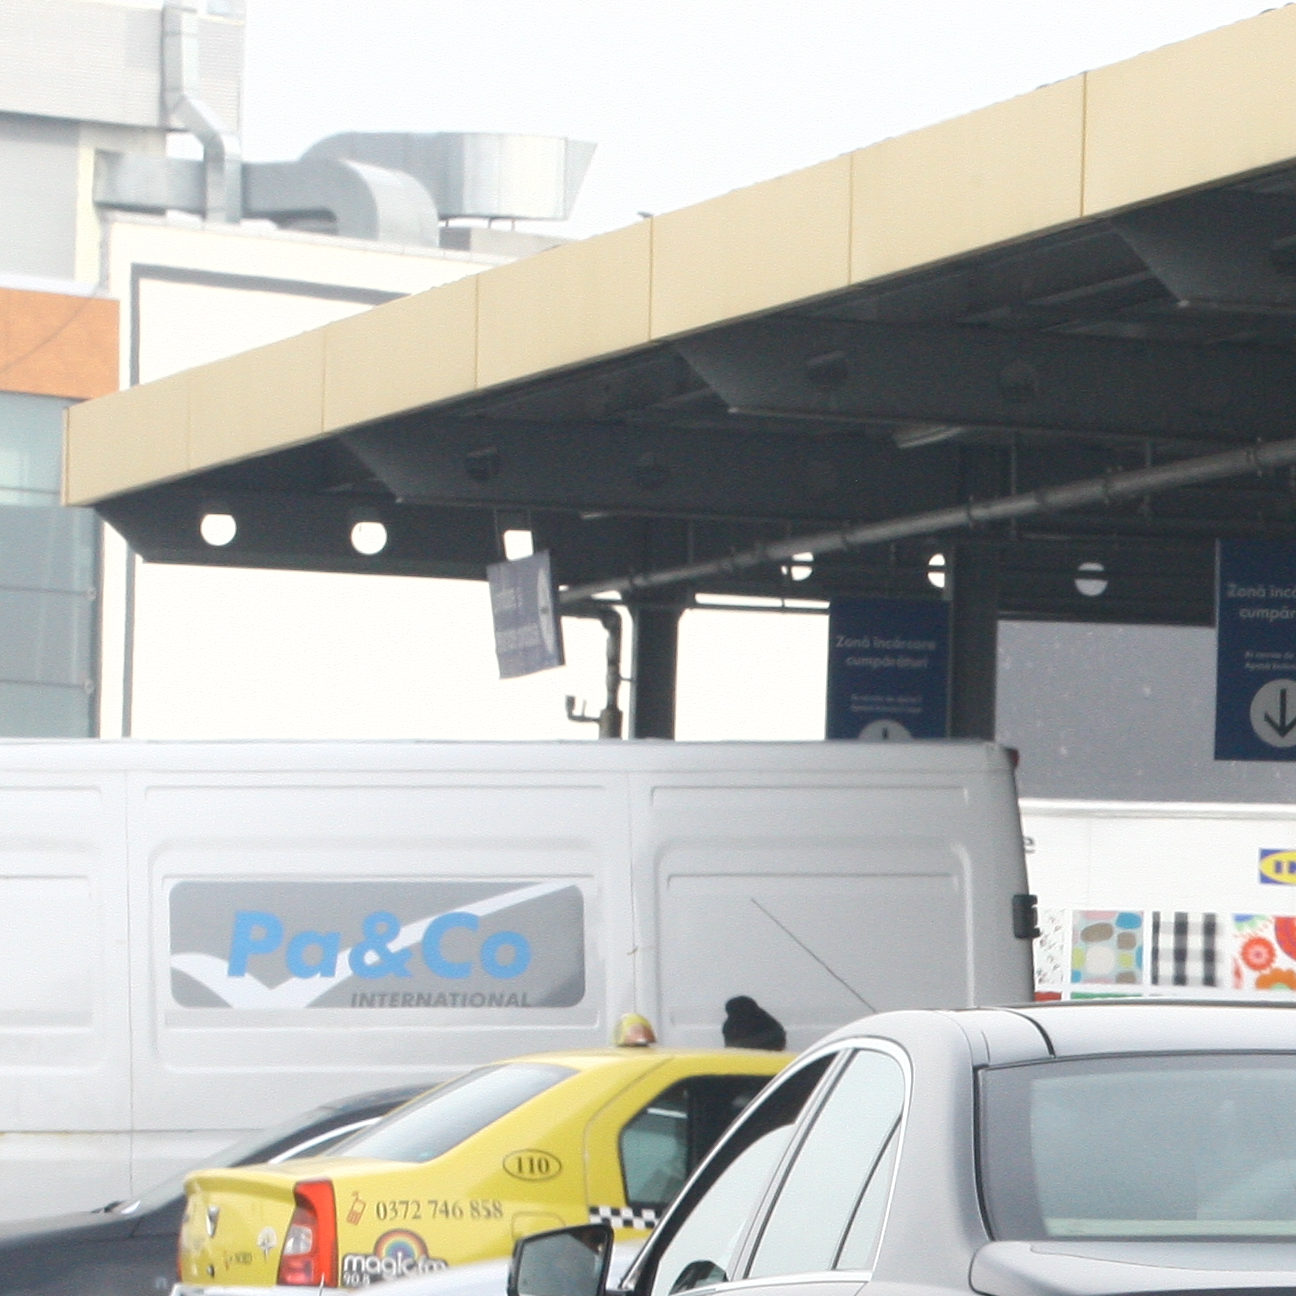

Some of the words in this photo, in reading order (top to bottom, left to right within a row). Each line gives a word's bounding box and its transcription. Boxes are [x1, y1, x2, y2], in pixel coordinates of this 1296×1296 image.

[1226, 582, 1267, 598] Zonă
[227, 910, 532, 980] Pa&Co
[350, 991, 531, 1009] INTERNATIONAL
[517, 1156, 550, 1174] 110
[376, 1200, 422, 1221] 0372
[428, 1200, 463, 1220] 746
[470, 1199, 503, 1219] 858
